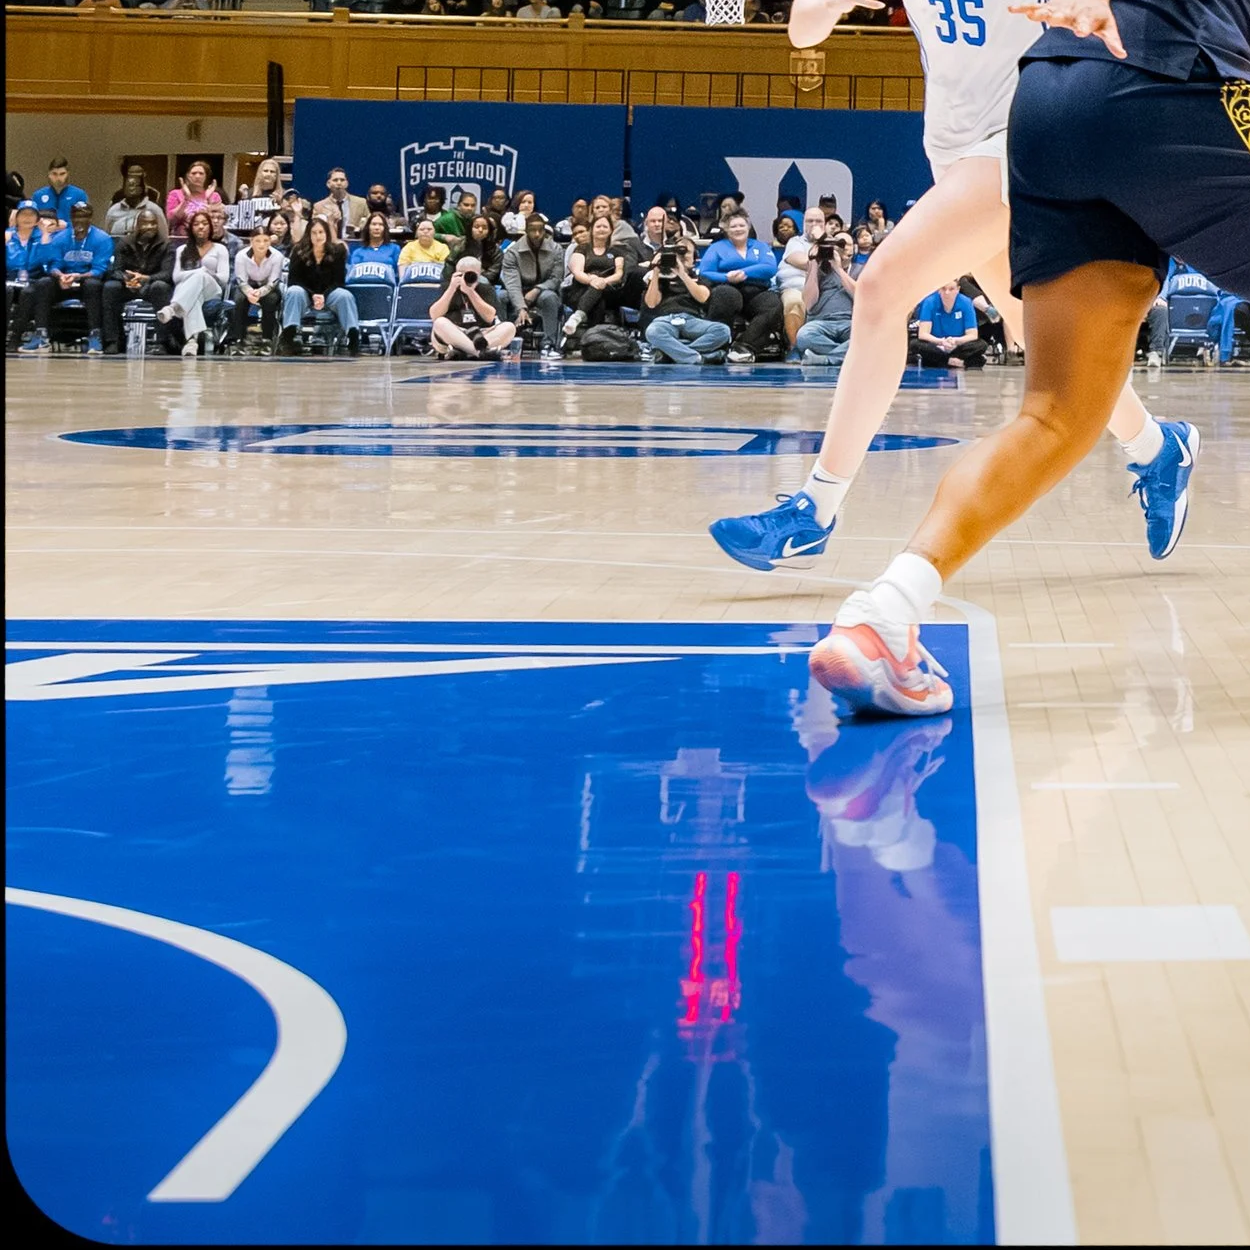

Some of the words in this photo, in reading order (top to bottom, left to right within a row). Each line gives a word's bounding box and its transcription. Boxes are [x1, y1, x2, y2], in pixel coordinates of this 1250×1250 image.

[453, 150, 465, 160] THE
[409, 160, 506, 188] SISTERHOOD
[355, 265, 385, 279] DUKE
[411, 264, 441, 279] DUKE
[1178, 275, 1208, 291] DUKE
